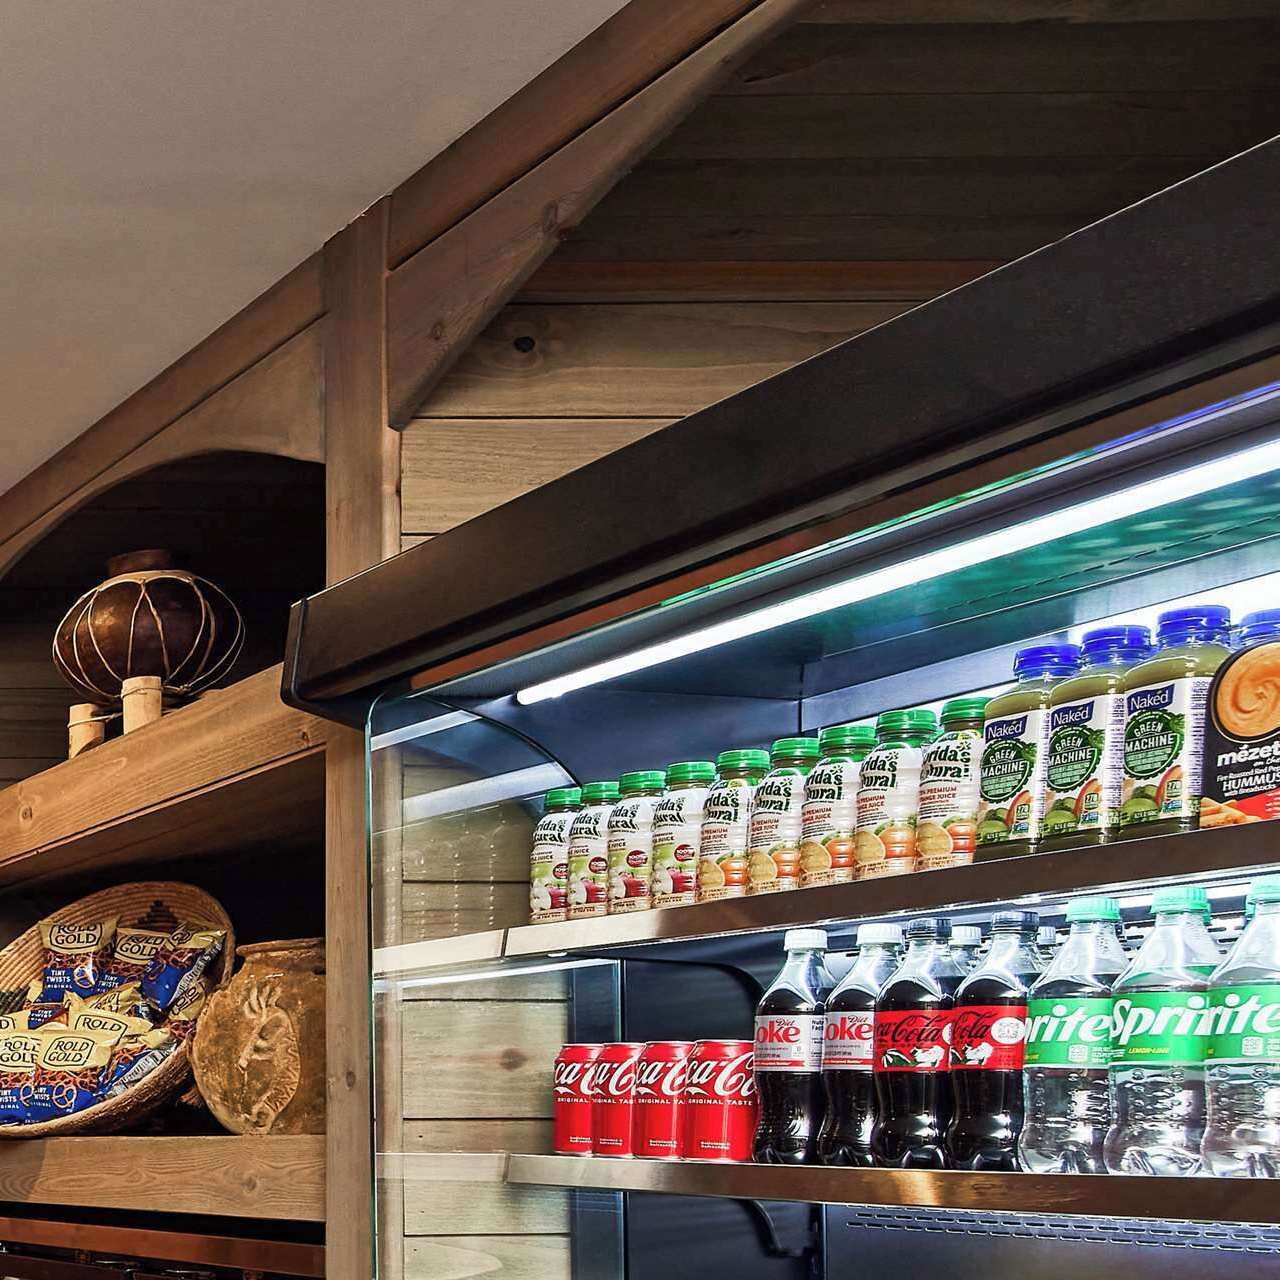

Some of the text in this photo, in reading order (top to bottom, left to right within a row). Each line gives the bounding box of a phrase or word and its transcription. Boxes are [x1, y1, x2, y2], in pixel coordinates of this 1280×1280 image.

[1130, 688, 1169, 711] Naked
[1053, 706, 1090, 727] Naked
[987, 721, 1023, 739] Naked
[1133, 721, 1164, 738] GREEN
[1055, 736, 1084, 752] GREEN
[1125, 733, 1175, 753] MACHINE
[990, 749, 1018, 764] GREEN
[1049, 749, 1093, 766] MACHINE
[981, 761, 1026, 777] MACHINE
[1216, 766, 1268, 783] Fire Roasted Red
[1222, 772, 1280, 791] HUMMUS
[928, 785, 957, 795] PREMIUM
[937, 792, 956, 800] JUICE
[1224, 789, 1238, 797] with
[860, 794, 886, 803] PREMIUM
[868, 801, 885, 809] JUICE
[807, 807, 832, 816] PREMIUM
[754, 818, 780, 827] PREMIUM
[55, 924, 97, 934] ROLD
[54, 933, 97, 945] GOLD
[125, 934, 165, 946] ROLD
[119, 942, 159, 957] GOLD
[51, 969, 66, 977] TINY
[103, 974, 118, 982] TINY
[97, 980, 119, 988] TWISTS
[81, 1016, 122, 1032] ROLD
[775, 1018, 796, 1027] Diet
[847, 1014, 869, 1024] Diet
[55, 1040, 90, 1052] ROLD
[1128, 1047, 1170, 1055] LEMON-LIME
[47, 1051, 84, 1063] GOLD
[688, 1098, 724, 1106] ORIGINAL
